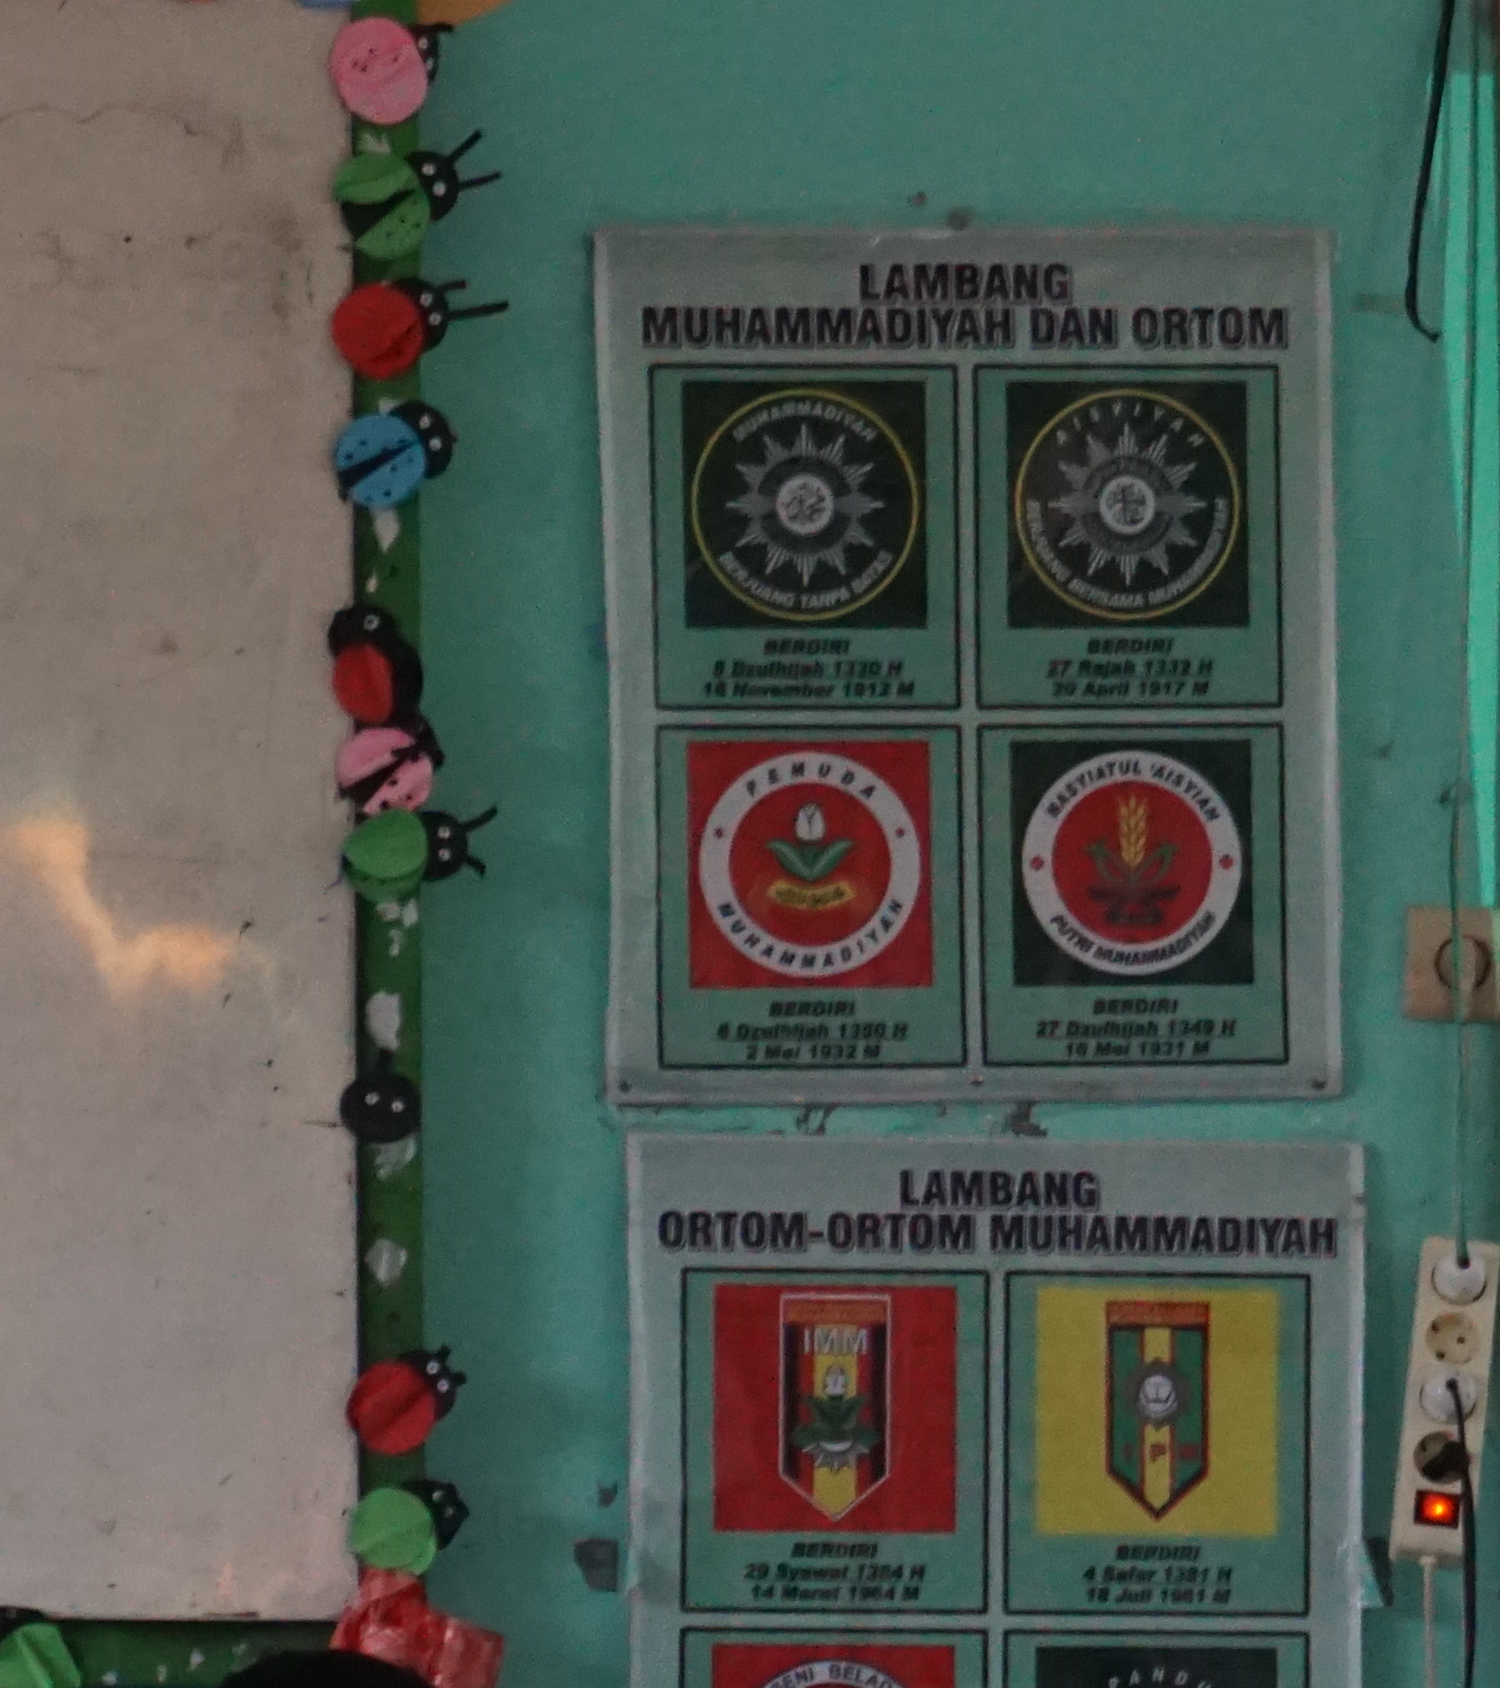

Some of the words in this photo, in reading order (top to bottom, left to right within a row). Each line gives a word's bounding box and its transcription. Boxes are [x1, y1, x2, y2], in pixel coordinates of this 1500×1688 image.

[860, 264, 1074, 302] LAMBANG
[642, 307, 1012, 350] MUHAMMADIYAH
[1030, 307, 1118, 350] DAN
[1132, 307, 1288, 350] ORTOM
[731, 399, 879, 444] MUHAMMADIYAH
[746, 761, 877, 799] PEMUDA
[1045, 758, 1143, 821] NASYIATUL
[717, 898, 903, 970] MUHAMMADIYAH
[768, 1000, 855, 1017] BERDIRI
[1092, 998, 1178, 1015] BERDIRI
[1036, 1020, 1060, 1038] 27
[1221, 1019, 1237, 1037] H
[901, 1170, 1099, 1209] LAMBANG
[658, 1210, 974, 1252] ORTOM-ORTOM
[990, 1215, 1338, 1257] MUHAMMADIYAH
[804, 1327, 868, 1355] IMM
